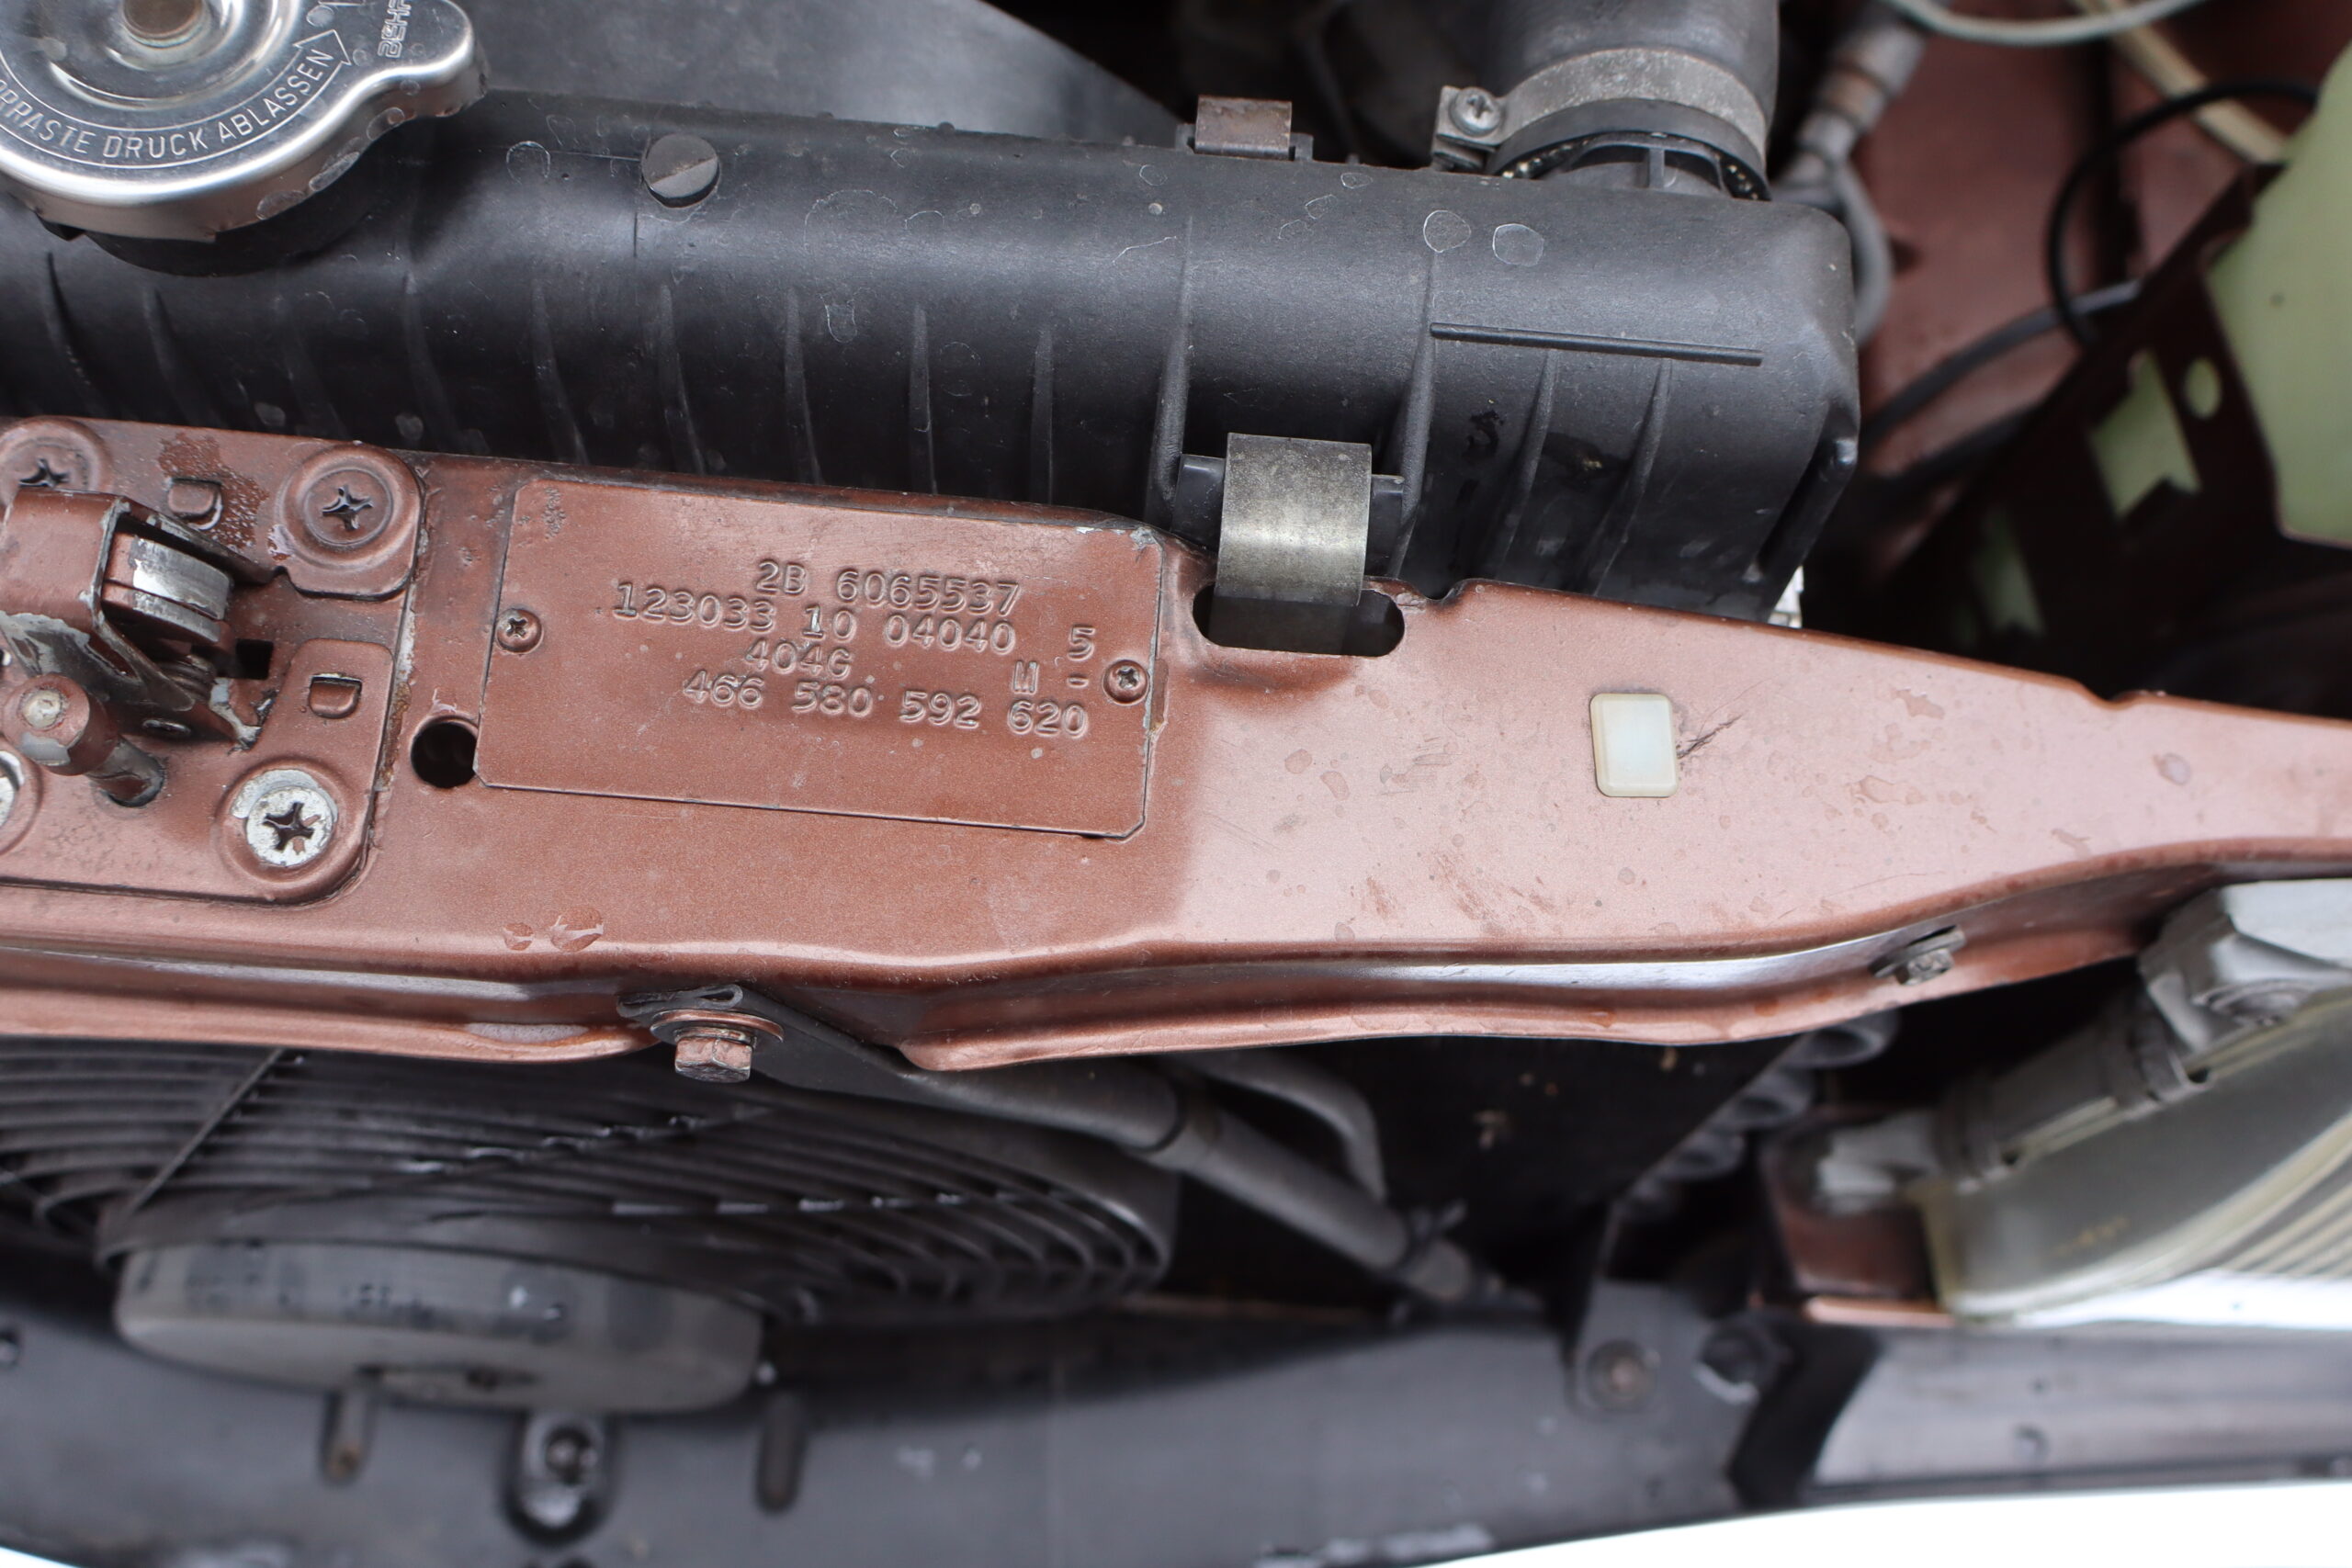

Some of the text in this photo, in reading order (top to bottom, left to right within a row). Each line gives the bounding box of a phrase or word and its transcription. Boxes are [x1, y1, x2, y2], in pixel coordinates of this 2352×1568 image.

[102, 127, 209, 159] DRUCK
[218, 49, 334, 144] ABLASSEN
[613, 581, 1096, 660] 123033 10 04040 5
[755, 559, 1021, 616] 2B 6065537
[744, 637, 853, 681] 404G
[683, 669, 1090, 739] 466 580 592 620
